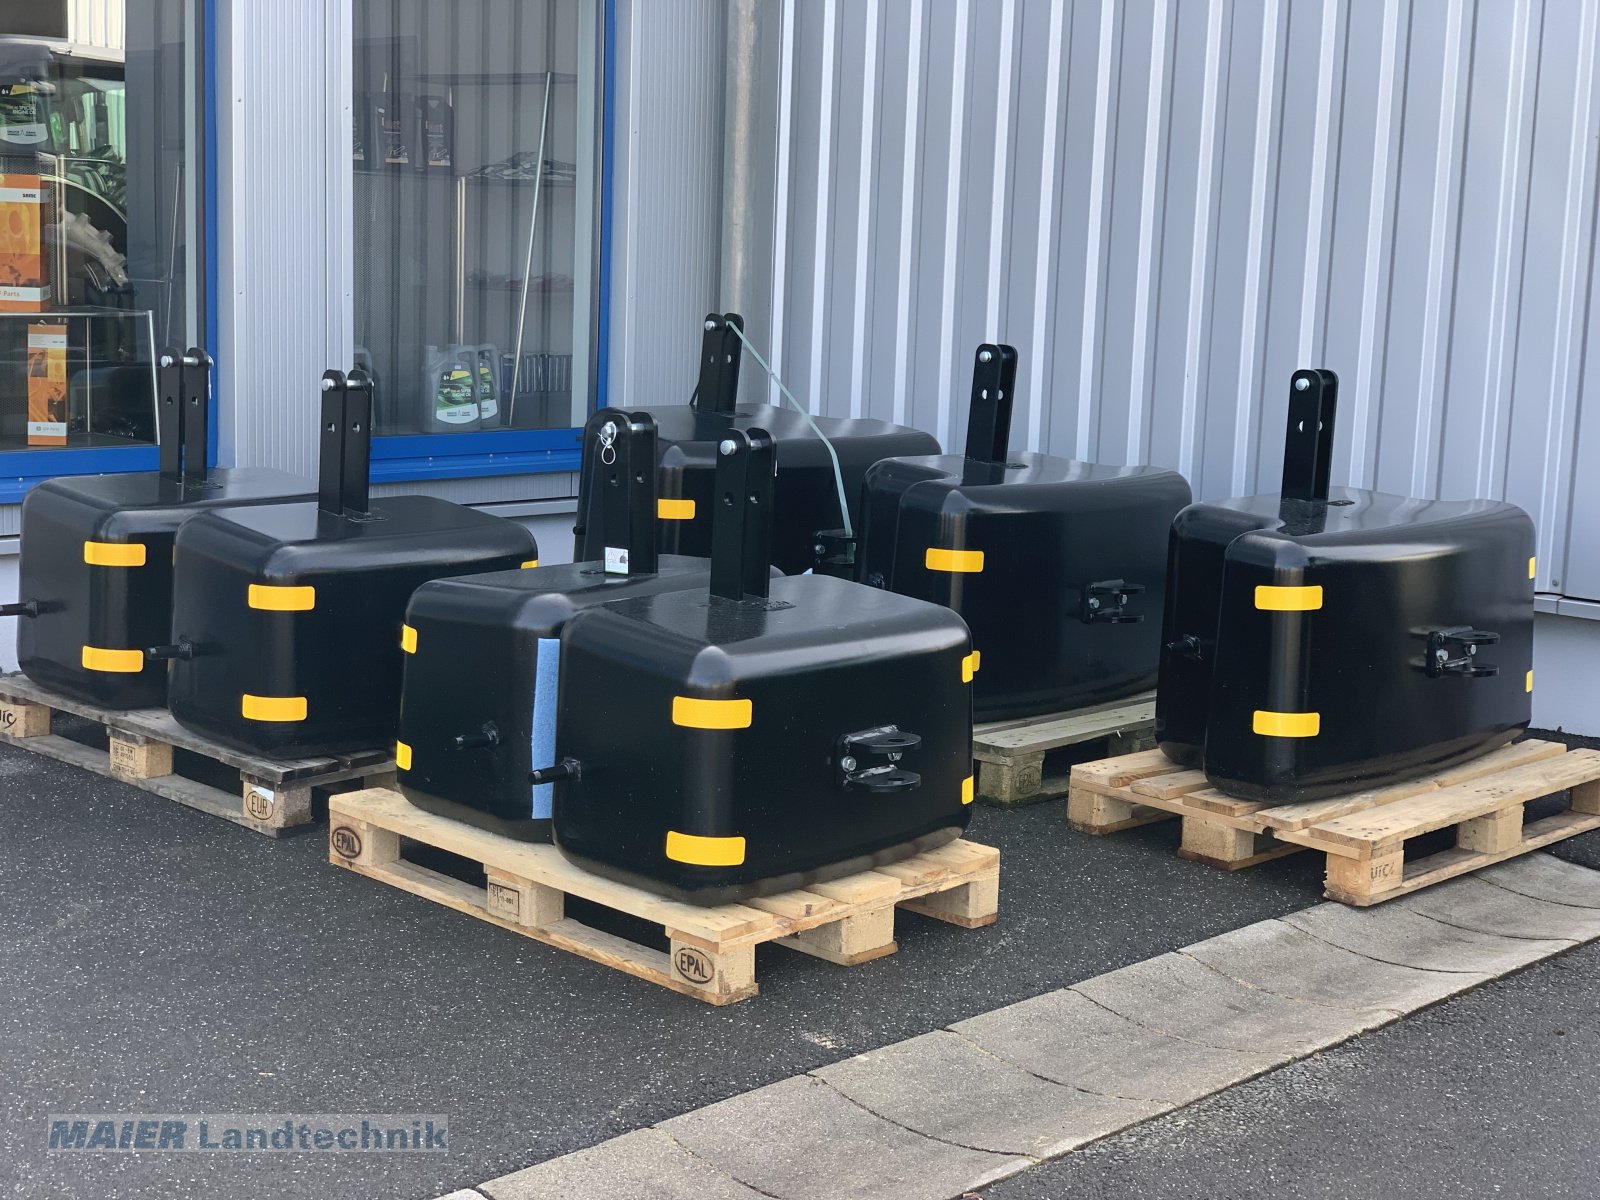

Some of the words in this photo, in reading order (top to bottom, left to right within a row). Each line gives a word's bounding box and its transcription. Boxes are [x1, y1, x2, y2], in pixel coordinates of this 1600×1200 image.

[251, 794, 268, 817] EUR
[336, 831, 357, 854] EPAL
[680, 952, 708, 979] EPAL
